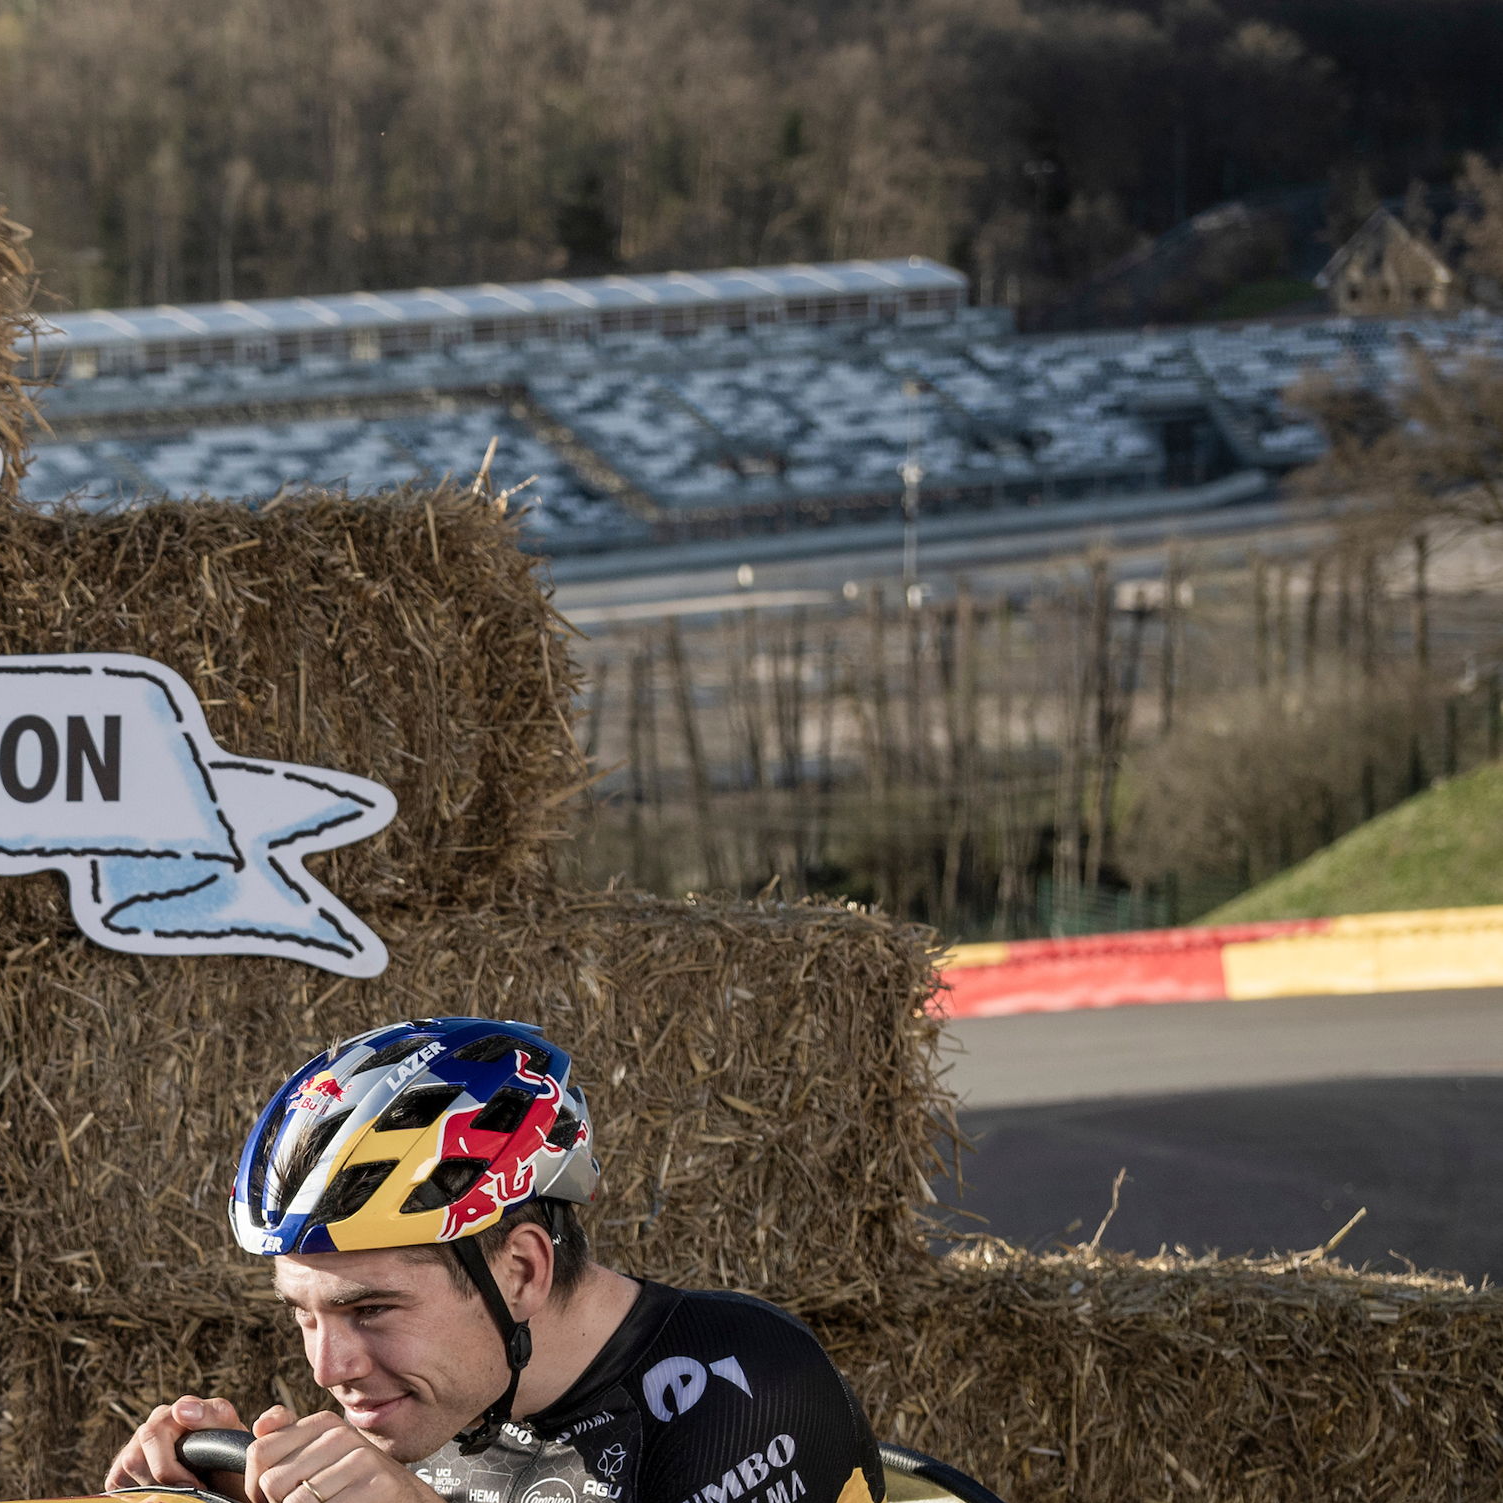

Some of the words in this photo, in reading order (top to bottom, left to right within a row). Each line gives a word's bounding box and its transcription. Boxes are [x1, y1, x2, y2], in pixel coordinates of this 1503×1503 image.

[385, 1041, 447, 1091] LAZER
[436, 1468, 452, 1477] UCI
[435, 1478, 461, 1487] WORLD
[582, 1480, 622, 1499] AGU
[469, 1488, 500, 1503] HEMA
